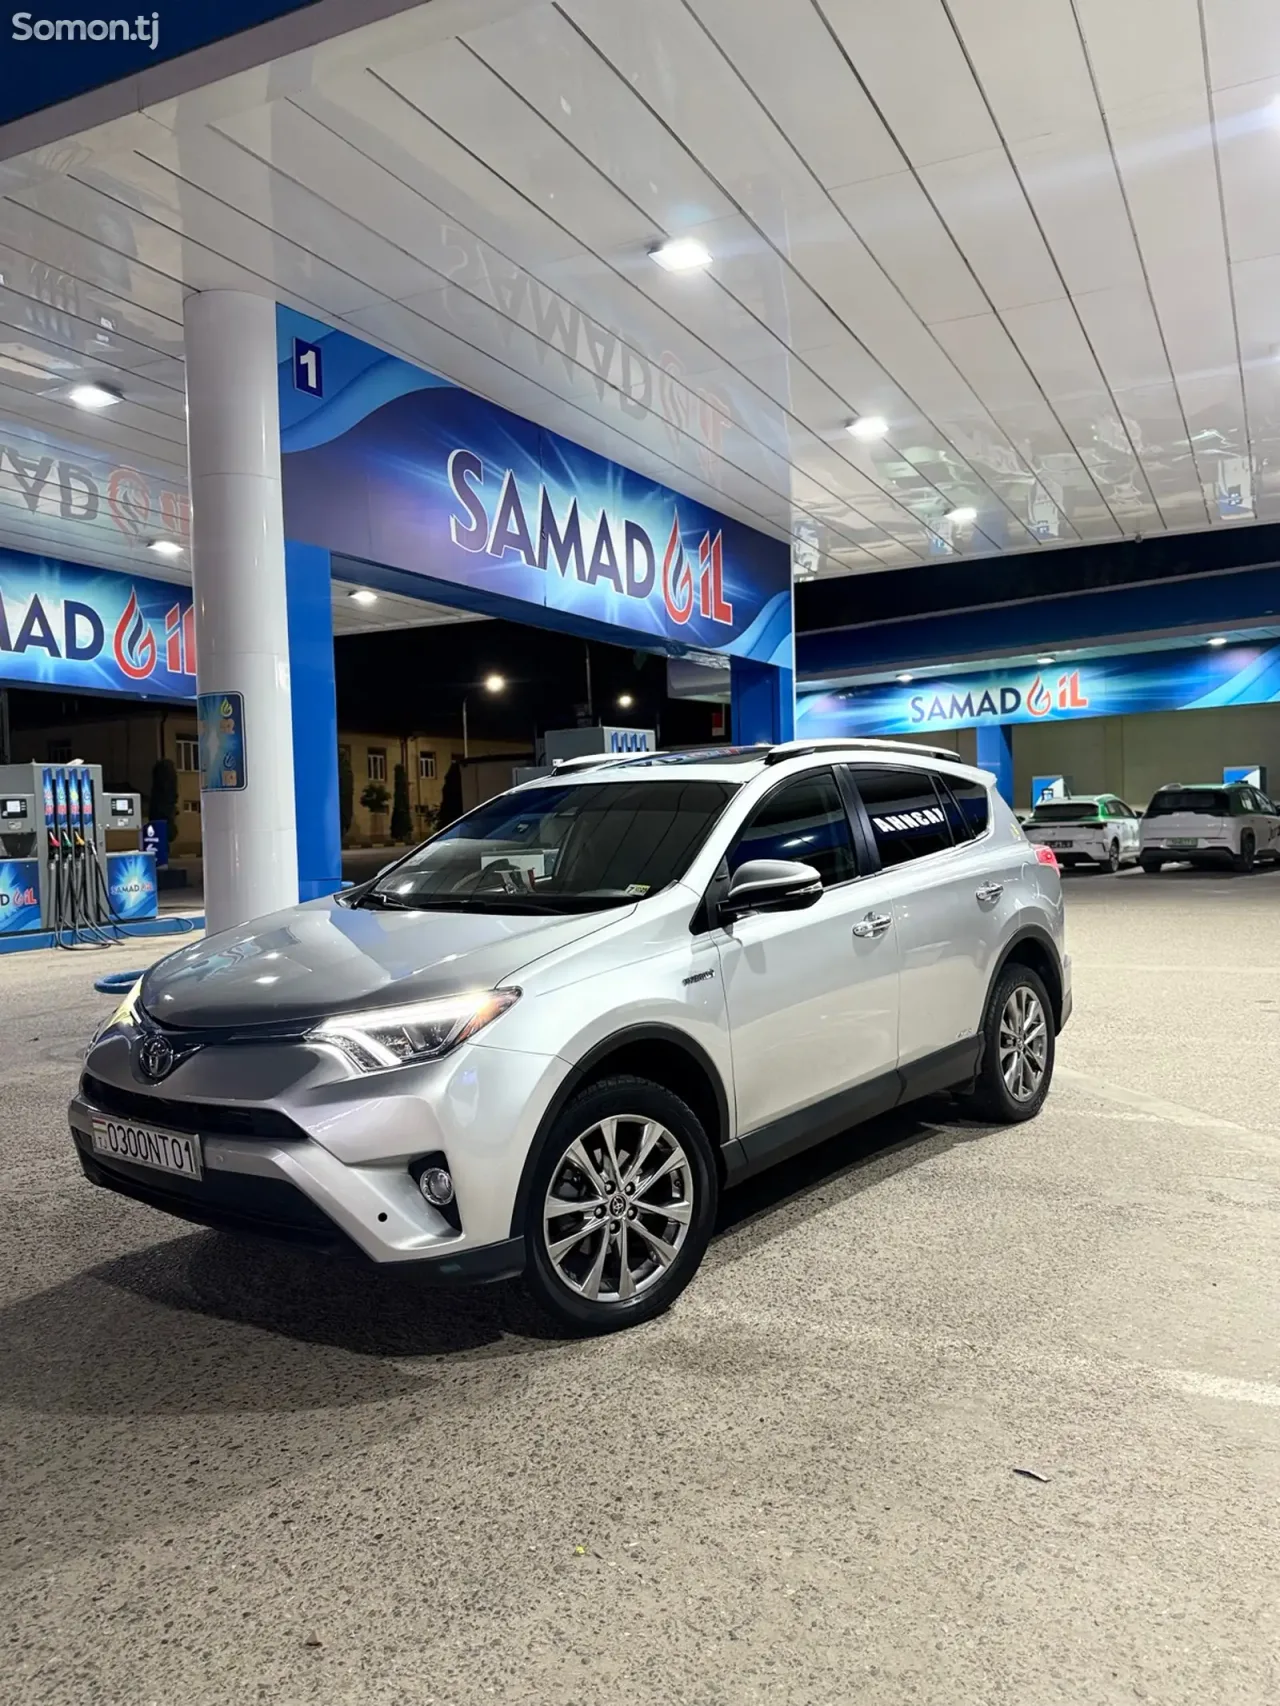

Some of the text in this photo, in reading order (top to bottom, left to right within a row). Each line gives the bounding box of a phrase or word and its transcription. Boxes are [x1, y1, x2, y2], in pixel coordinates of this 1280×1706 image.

[300, 350, 317, 388] 1
[447, 449, 656, 599] SAMAD
[910, 687, 1022, 724] SAMAD
